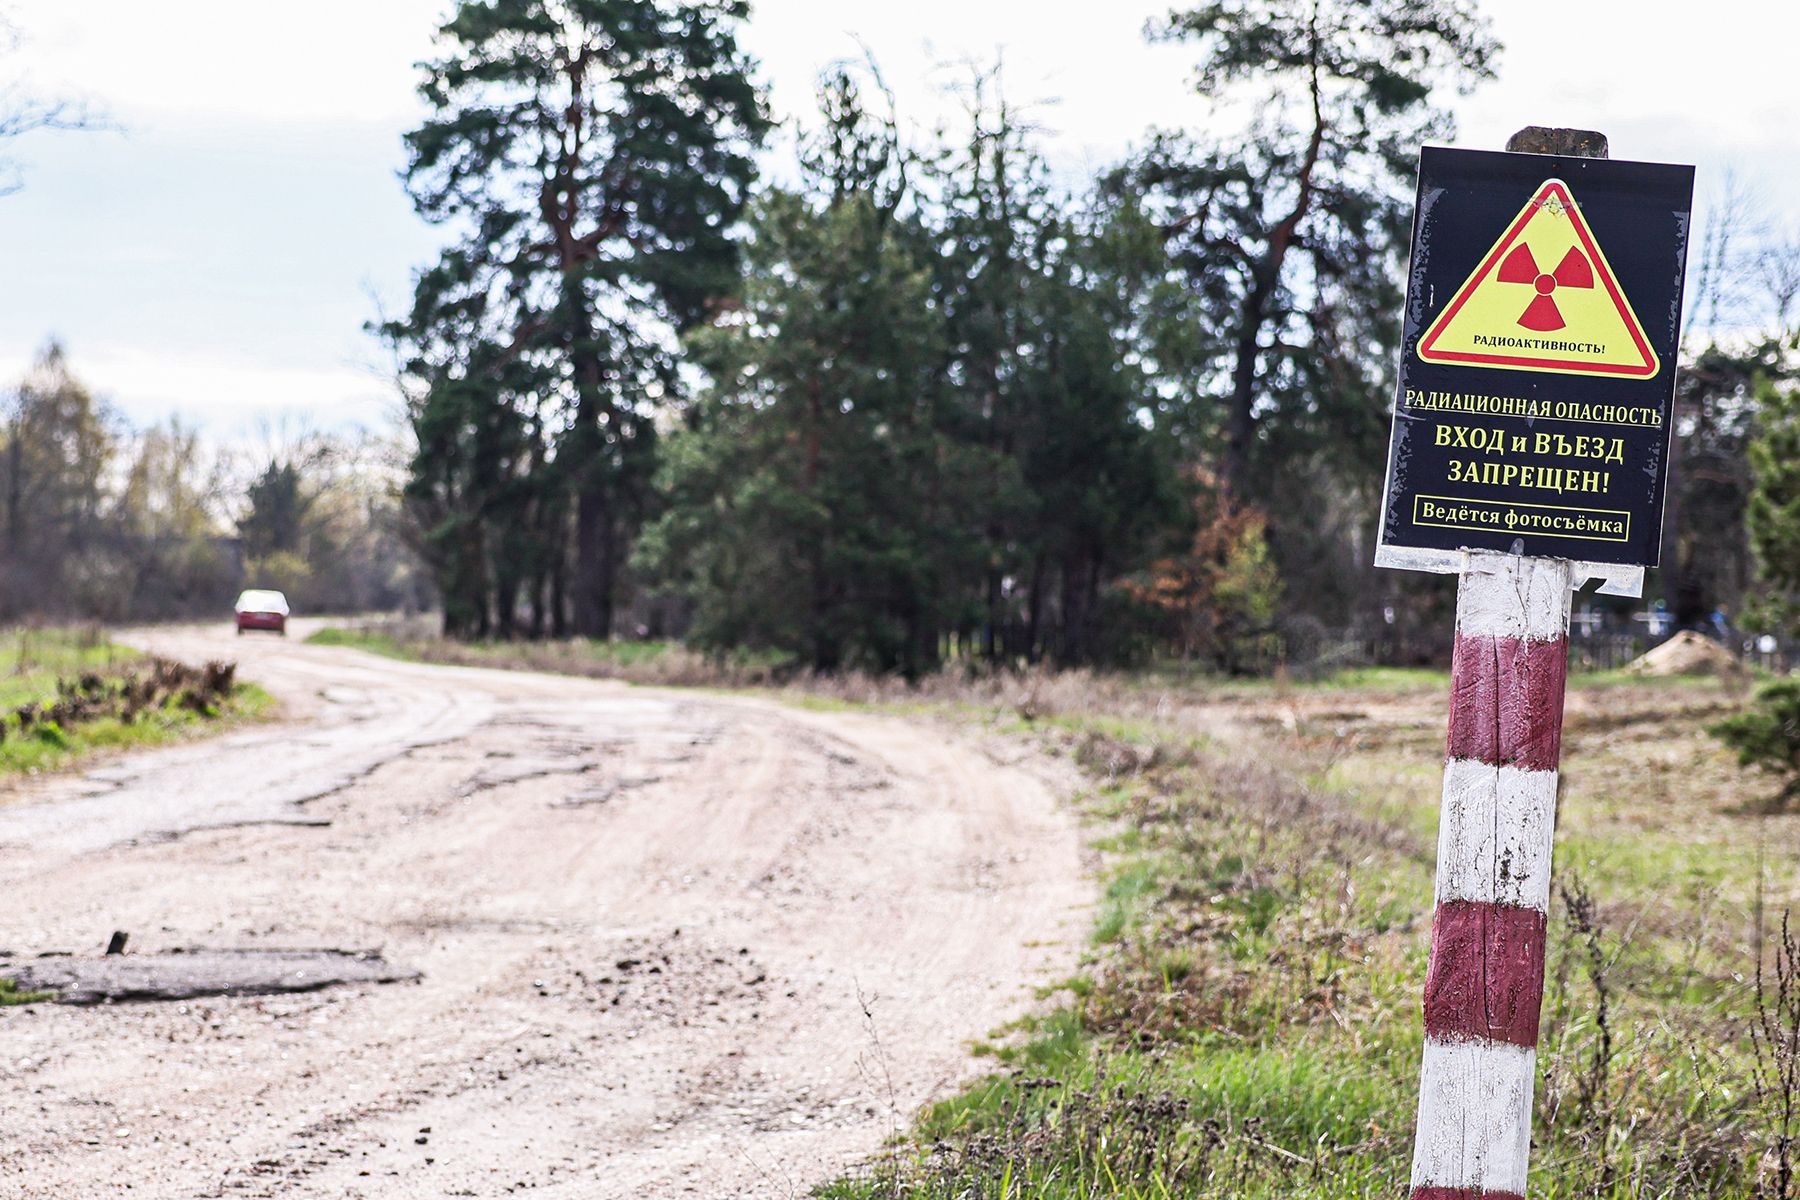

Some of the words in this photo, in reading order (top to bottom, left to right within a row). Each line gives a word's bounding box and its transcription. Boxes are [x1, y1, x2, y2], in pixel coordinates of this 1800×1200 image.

[1473, 335, 1605, 354] РАДИОАКТИВНОСТЬ!
[1404, 389, 1552, 417] РАДИАЦИОННАЯ
[1555, 401, 1662, 425] ОПАСНОСТЬ
[1434, 424, 1505, 455] ВХОД
[1511, 437, 1527, 452] и
[1533, 433, 1625, 464] ВЪЕЗД
[1447, 460, 1610, 495] ЗАПРЕЩЕН!
[1422, 502, 1500, 524] Ведётся
[1504, 508, 1624, 533] фотосъёмка
